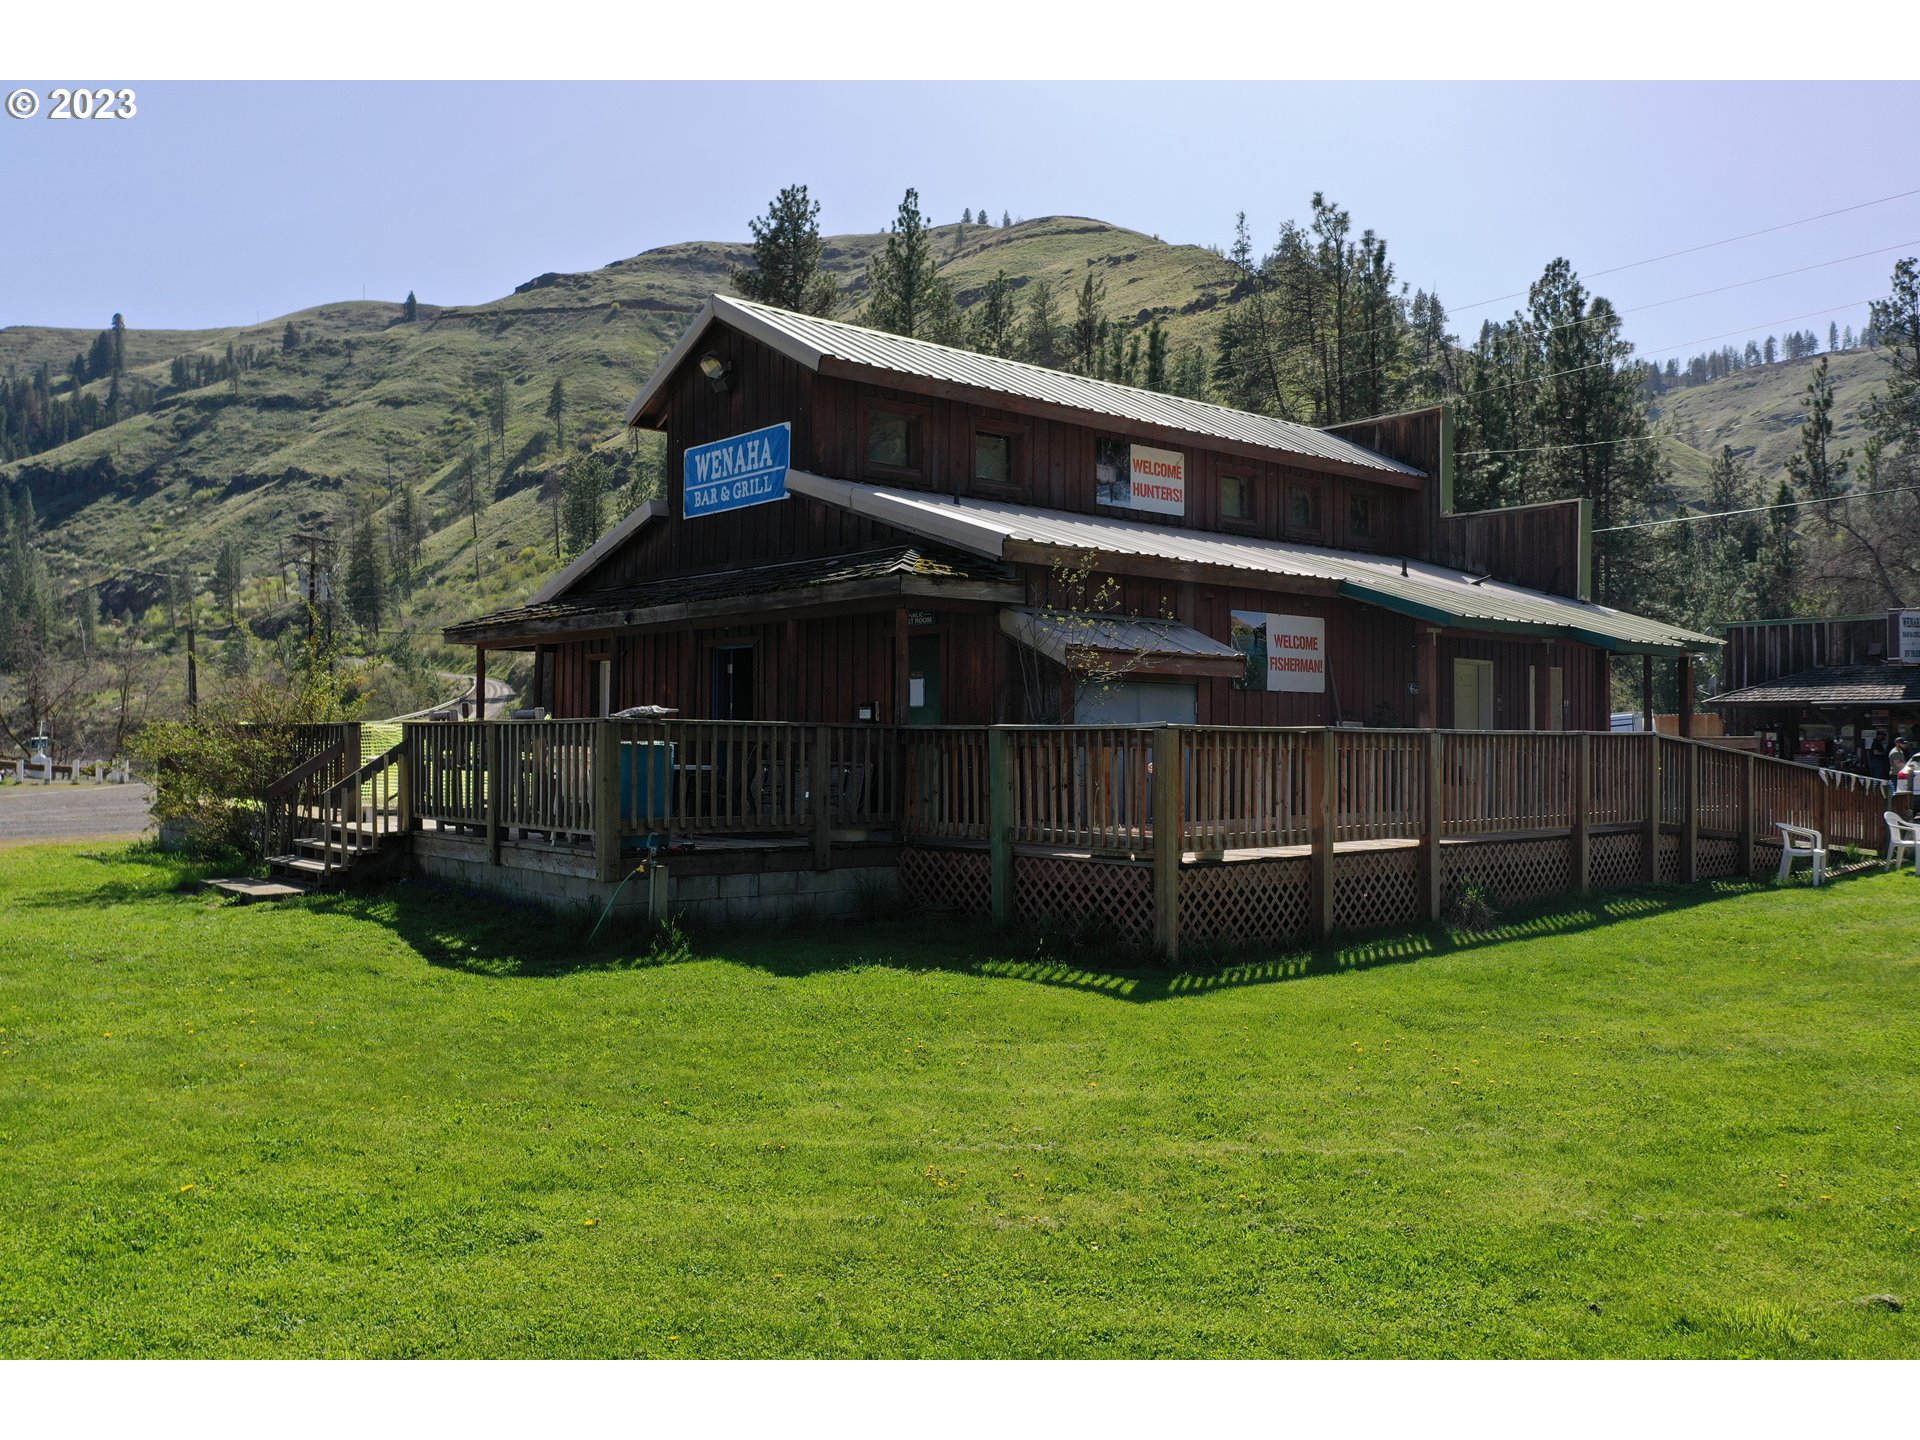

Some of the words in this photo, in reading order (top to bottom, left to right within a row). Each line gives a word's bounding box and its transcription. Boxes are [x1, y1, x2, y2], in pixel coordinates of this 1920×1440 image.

[694, 437, 773, 483] WENAHA
[1132, 458, 1182, 480] WELCOME
[694, 488, 718, 508] BAR
[720, 486, 730, 502] &
[732, 476, 772, 499] GRILL
[1132, 482, 1183, 503] HUNTERS!
[1273, 634, 1319, 651] WELCOME
[1269, 656, 1323, 673] FISHERMAN!
